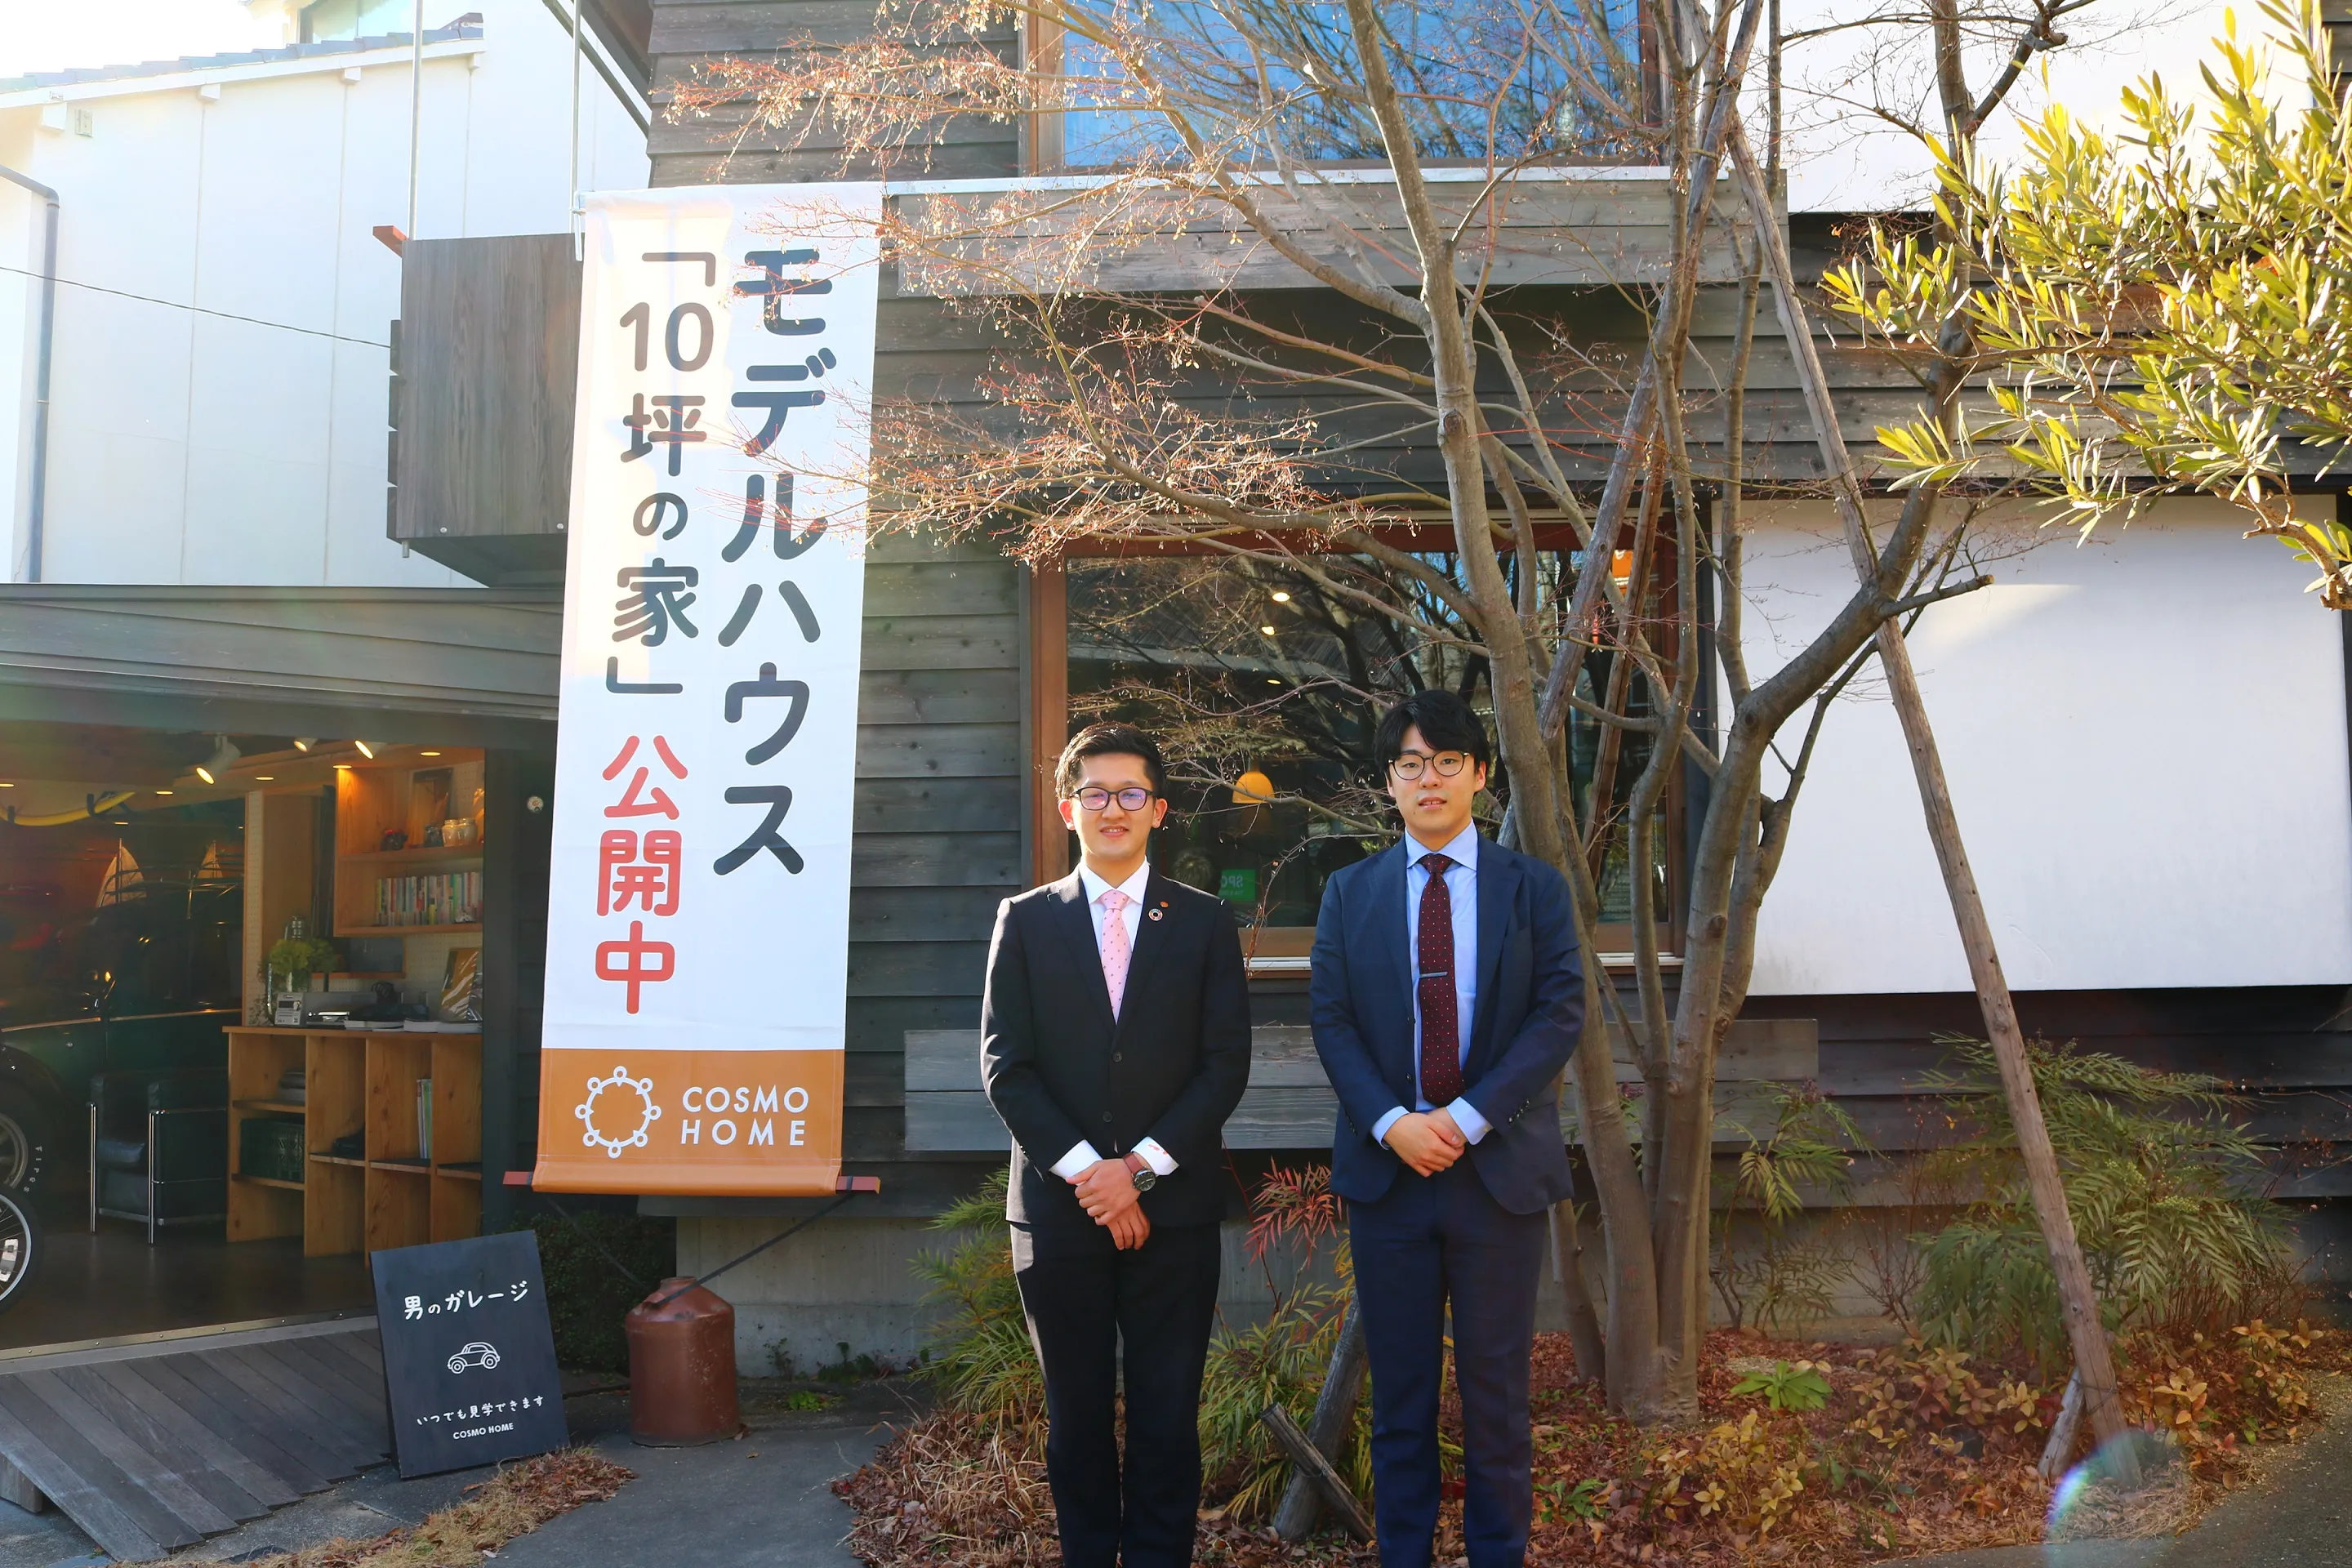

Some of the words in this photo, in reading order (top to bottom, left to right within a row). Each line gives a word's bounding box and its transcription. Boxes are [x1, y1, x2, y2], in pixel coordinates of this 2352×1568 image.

[714, 249, 836, 875] モデルハウス
[682, 1085, 809, 1113] COSMO
[681, 1119, 805, 1147] HOME
[404, 1280, 528, 1320] 男のガレージ
[416, 1395, 544, 1425] いつでも見学できます
[452, 1427, 487, 1440] COSMO
[488, 1423, 514, 1434] HOME
